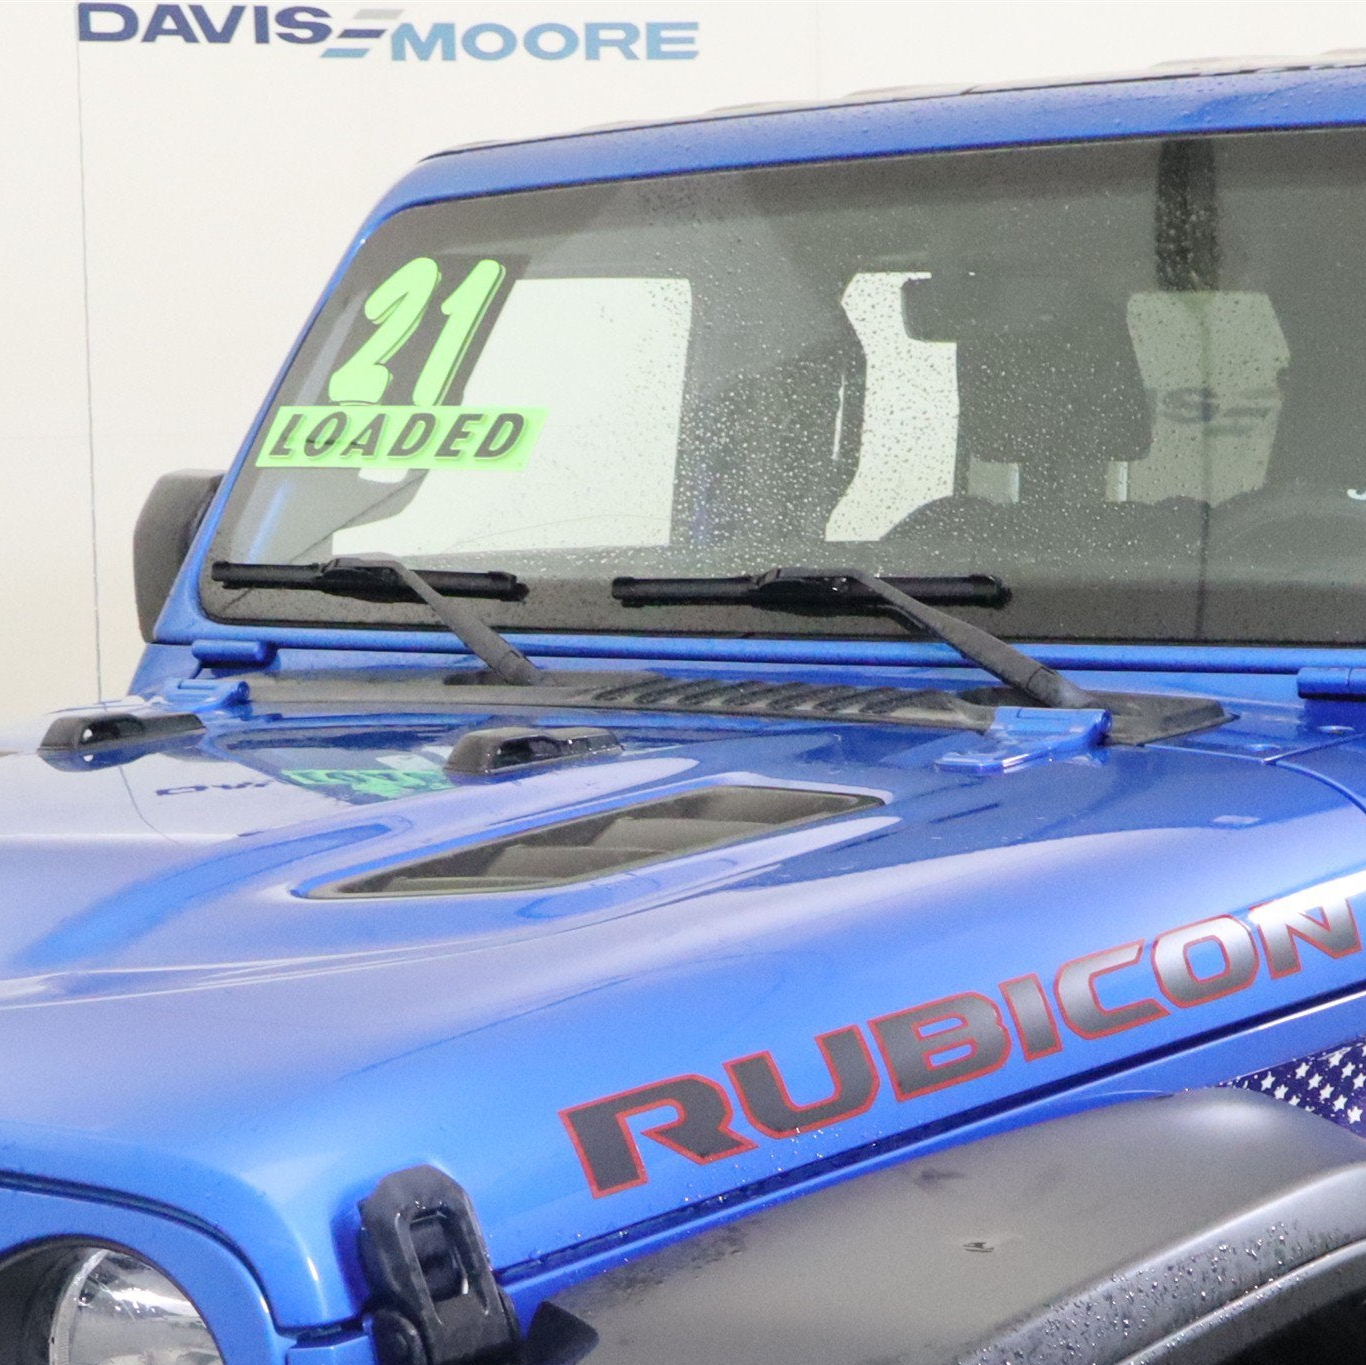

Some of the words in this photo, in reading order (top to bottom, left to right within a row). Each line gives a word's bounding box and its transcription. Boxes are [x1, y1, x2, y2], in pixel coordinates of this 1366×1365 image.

[77, 2, 332, 45] DAVIS
[390, 21, 699, 62] MOORE
[329, 256, 506, 406] 21
[268, 410, 528, 461] LOADED
[559, 898, 1362, 1198] RUBICON
